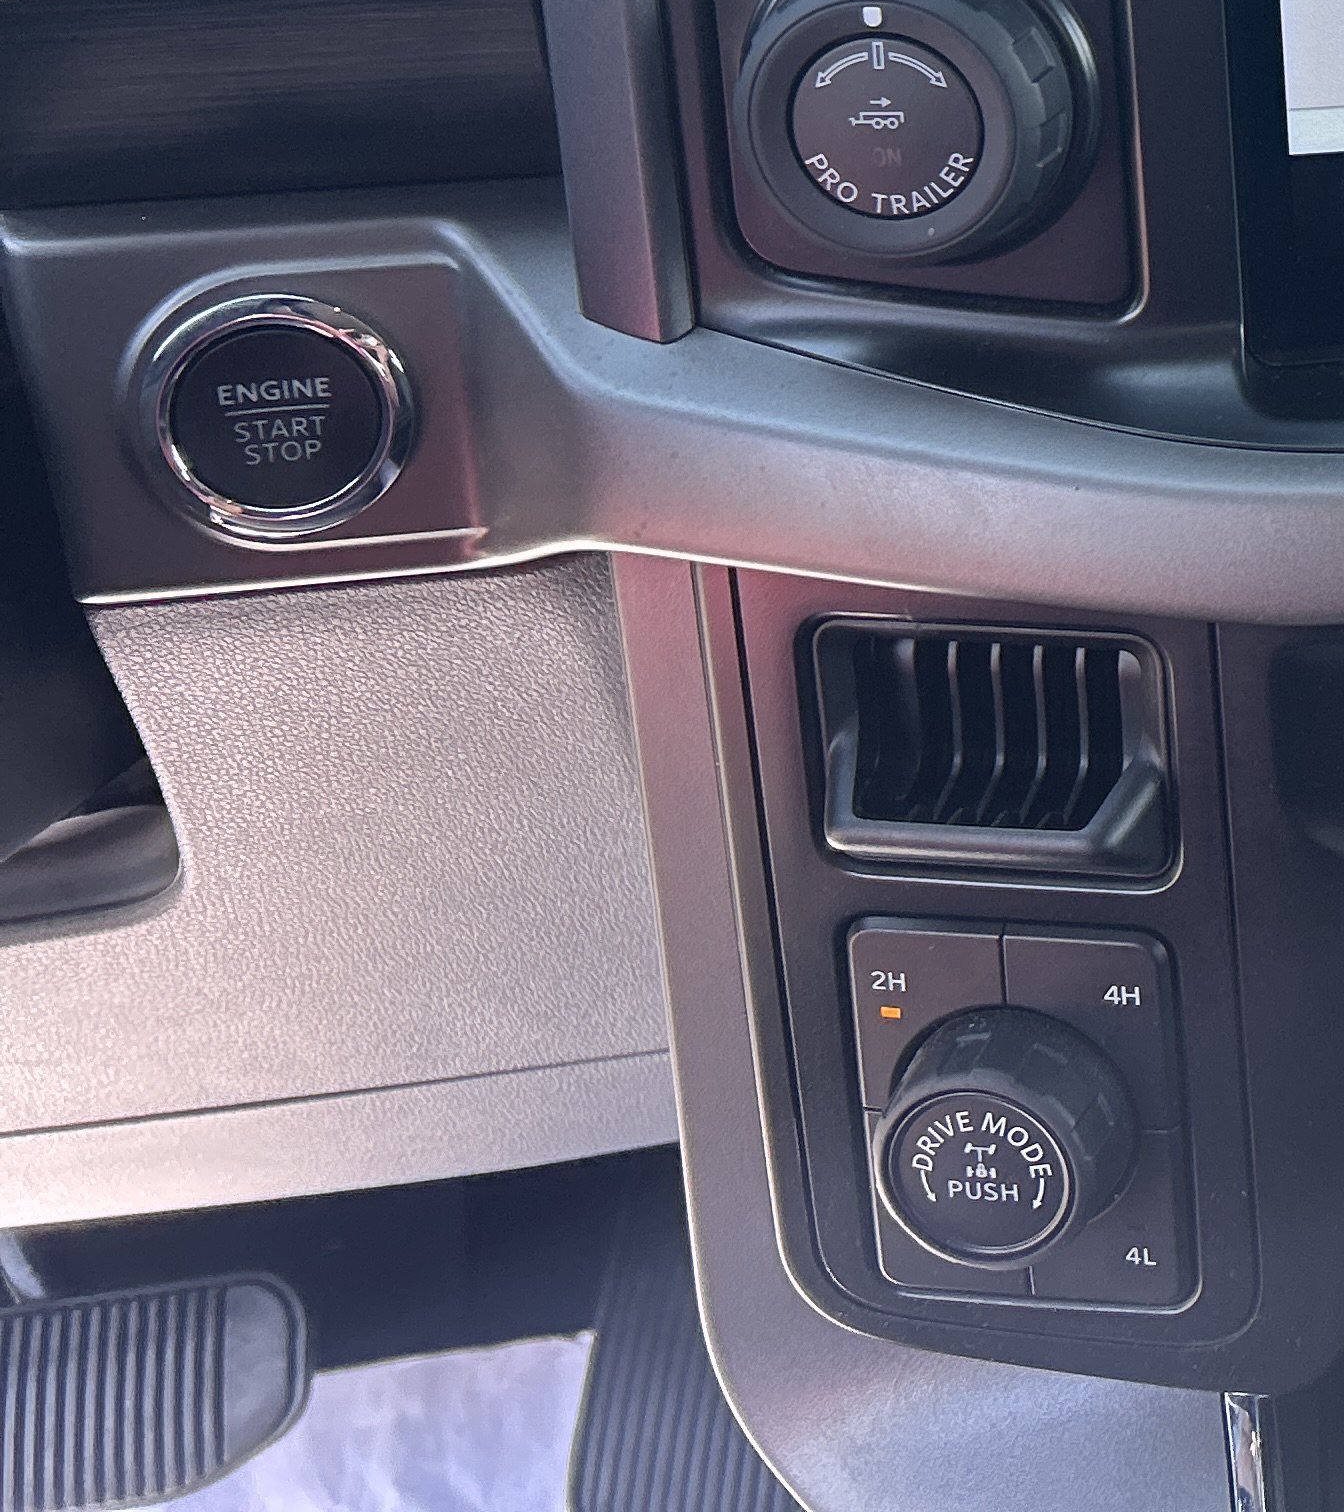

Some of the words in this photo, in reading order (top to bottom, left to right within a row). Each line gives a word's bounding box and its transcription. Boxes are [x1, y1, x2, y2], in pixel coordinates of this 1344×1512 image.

[805, 153, 858, 204] PRO
[871, 152, 974, 215] TRAILER
[217, 378, 332, 406] ENGINE
[234, 415, 325, 443] START
[245, 440, 322, 465] STOP
[871, 970, 906, 991] 2H
[1103, 985, 1141, 1006] 4H
[912, 1110, 974, 1173] DRIVE
[981, 1112, 1052, 1178] MODE
[948, 1180, 1019, 1201] PUSH
[1125, 1248, 1157, 1266] 4L
